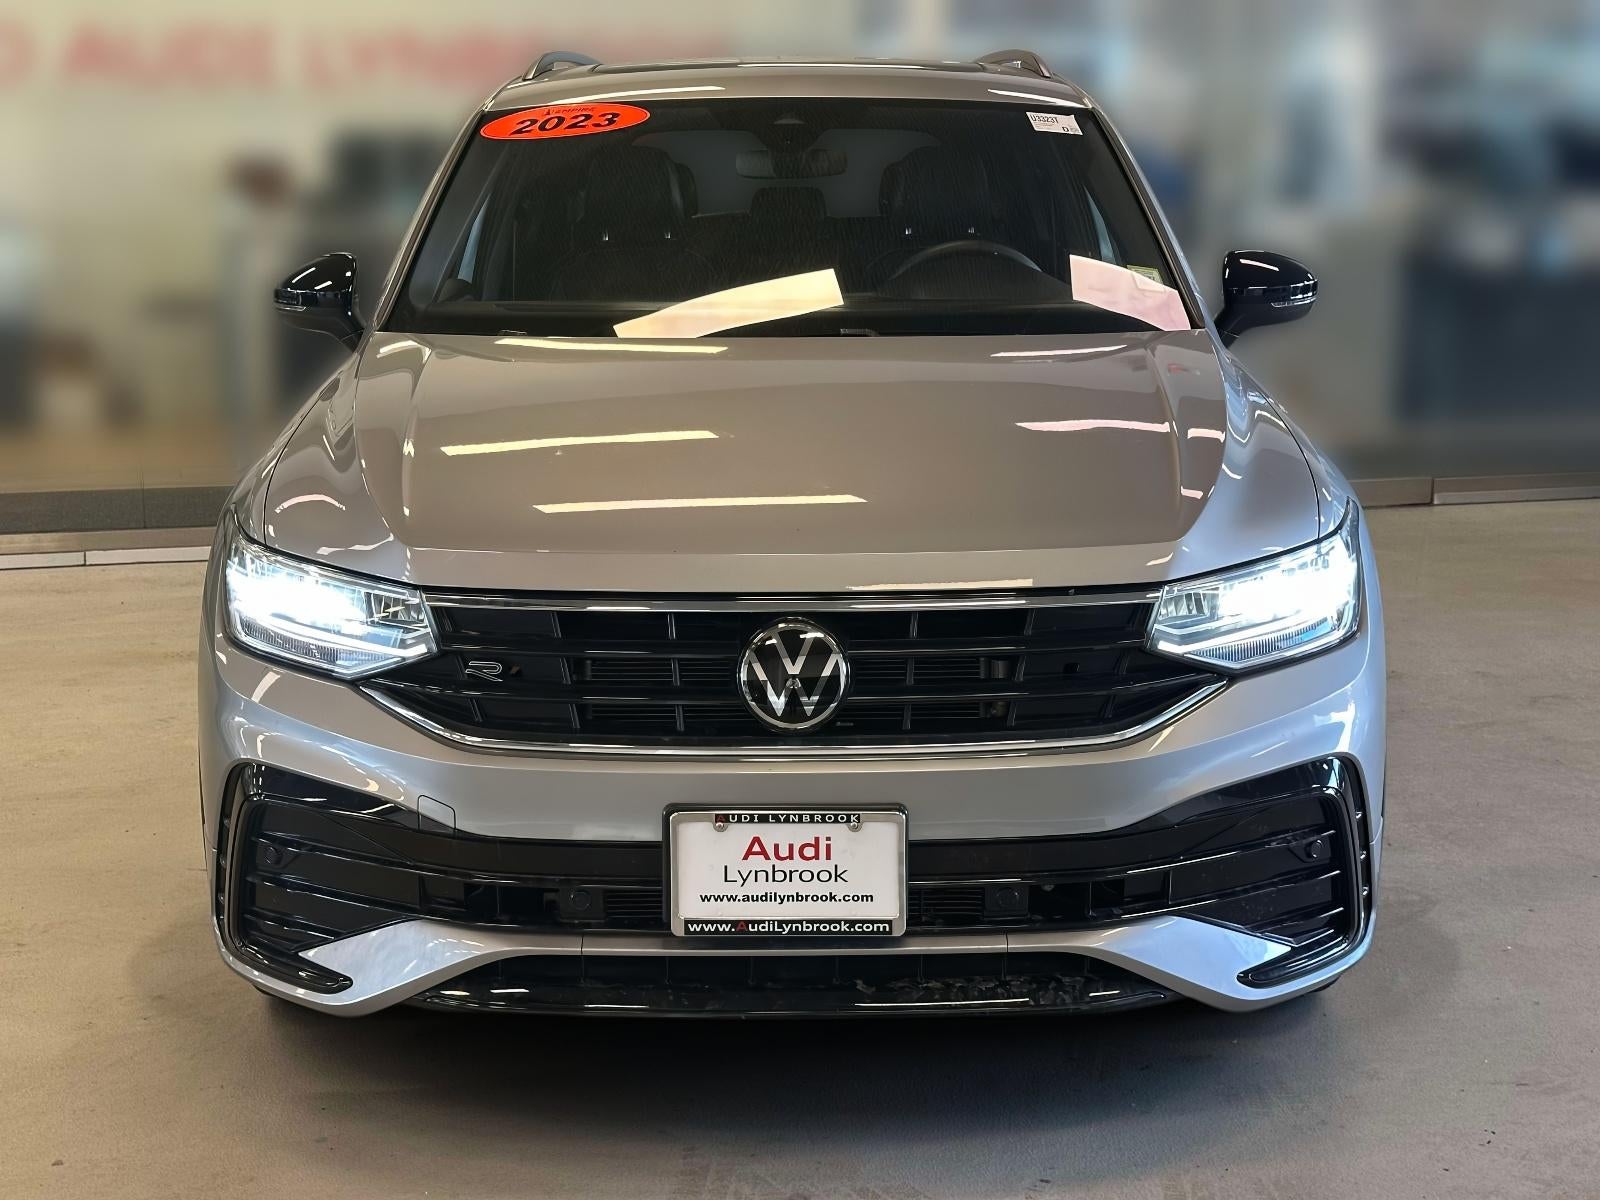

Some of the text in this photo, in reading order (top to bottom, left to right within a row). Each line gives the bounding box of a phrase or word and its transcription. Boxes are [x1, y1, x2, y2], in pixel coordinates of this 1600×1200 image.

[508, 112, 621, 136] 2023
[743, 623, 846, 724] VW
[716, 814, 859, 823] AUDI LYNBROOK
[742, 836, 832, 862] Audi
[723, 864, 849, 888] Lynbrook
[699, 891, 874, 905] www.audilynbrook.com
[688, 921, 889, 935] www.AudiLynbrook.com
